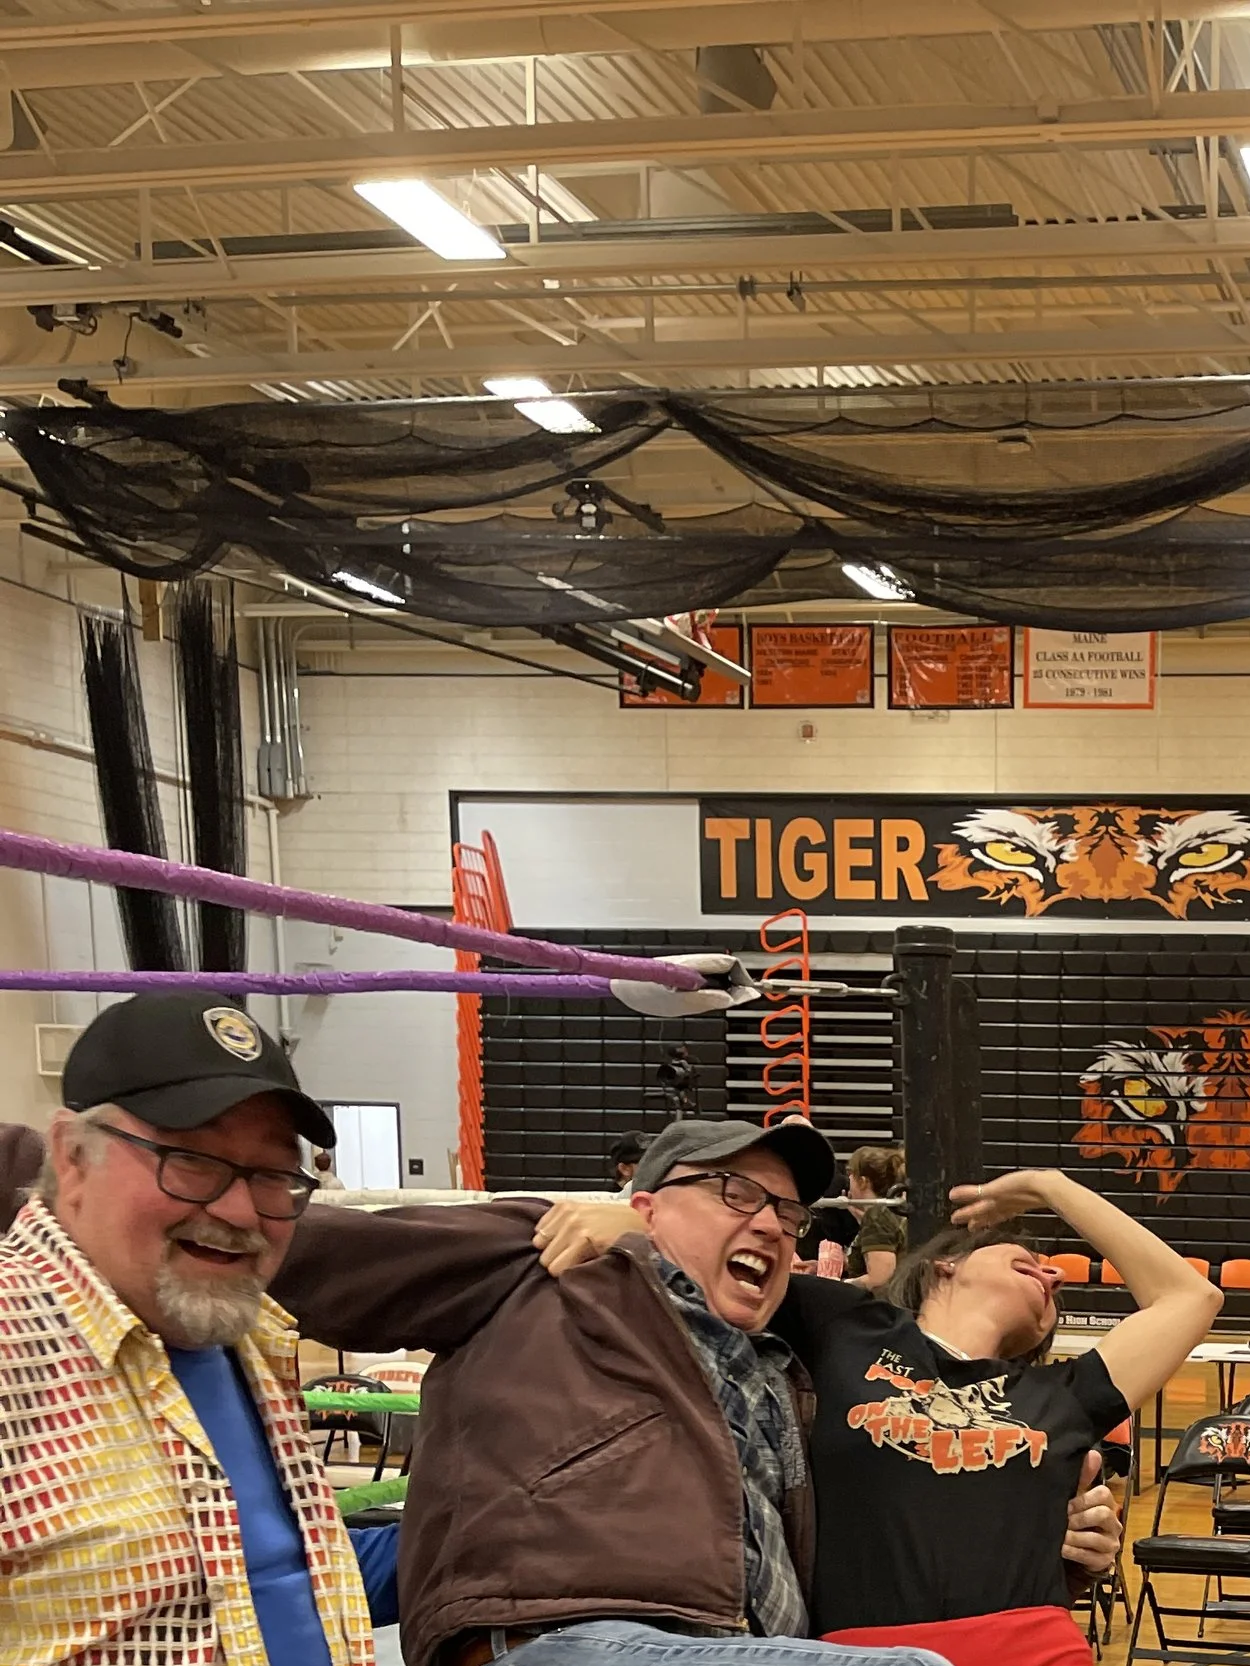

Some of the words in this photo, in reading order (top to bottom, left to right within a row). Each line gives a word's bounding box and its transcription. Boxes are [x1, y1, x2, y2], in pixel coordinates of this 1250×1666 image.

[894, 631, 993, 645] FOOTBALL
[1071, 633, 1108, 645] MAINE
[1035, 651, 1069, 663] CLASS
[1071, 651, 1086, 663] AA
[1087, 651, 1144, 663] FOOTBALL
[1045, 668, 1118, 681] CONSECUTIVE
[1119, 668, 1146, 680] WINS
[704, 816, 930, 901] TIGER
[881, 1348, 902, 1363] THE
[876, 1357, 915, 1378] LAST
[847, 1399, 891, 1430] ON
[863, 1416, 932, 1449] THE
[930, 1427, 1048, 1475] LEFT
